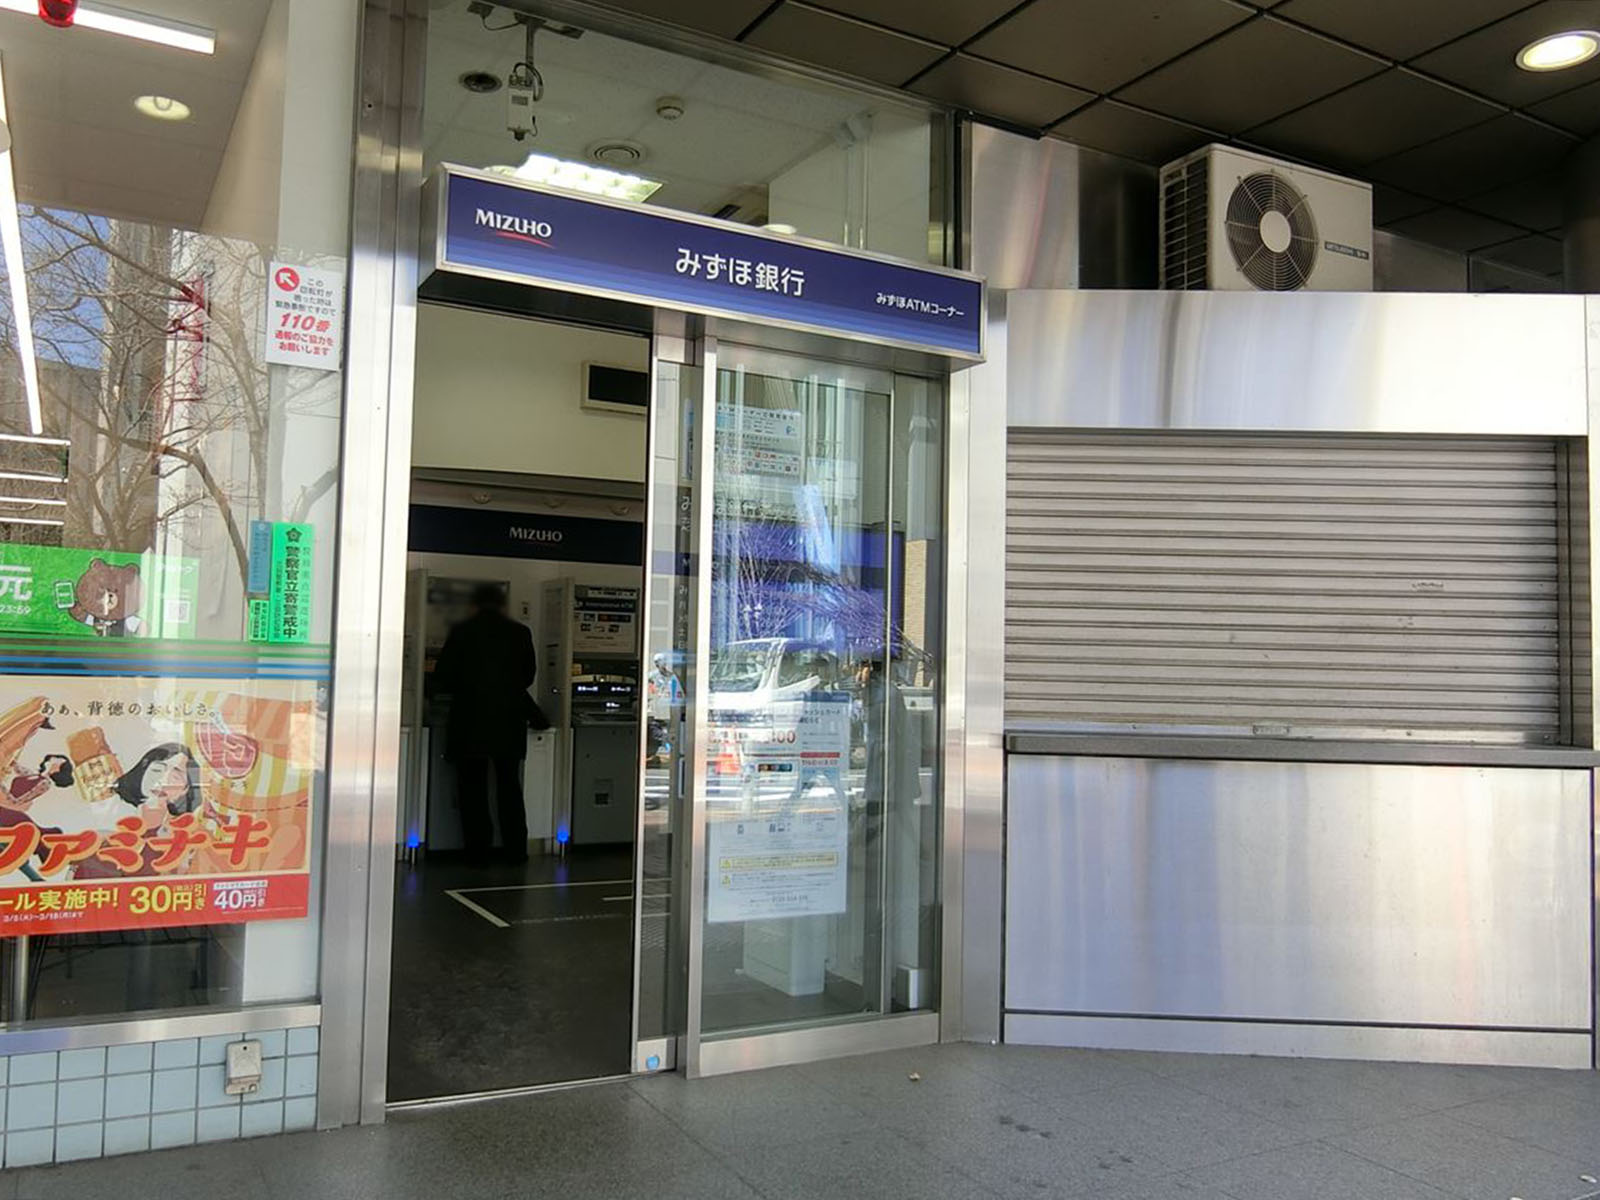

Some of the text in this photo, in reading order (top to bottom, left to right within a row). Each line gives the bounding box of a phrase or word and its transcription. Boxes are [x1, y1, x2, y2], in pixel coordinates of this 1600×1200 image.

[475, 208, 552, 238] MIZUHO
[675, 247, 806, 296] みずほ銀行
[876, 292, 965, 318] みずほATMコーナー
[281, 312, 331, 333] 110番
[275, 330, 334, 346] 通報のご協力を
[279, 342, 330, 356] お願いします
[509, 526, 563, 542] MIZUHO
[283, 545, 300, 639] 警察官立寄警戒中
[41, 700, 218, 717] あぁ、背徳のおいしさ。
[0, 813, 271, 876] ファミチキ
